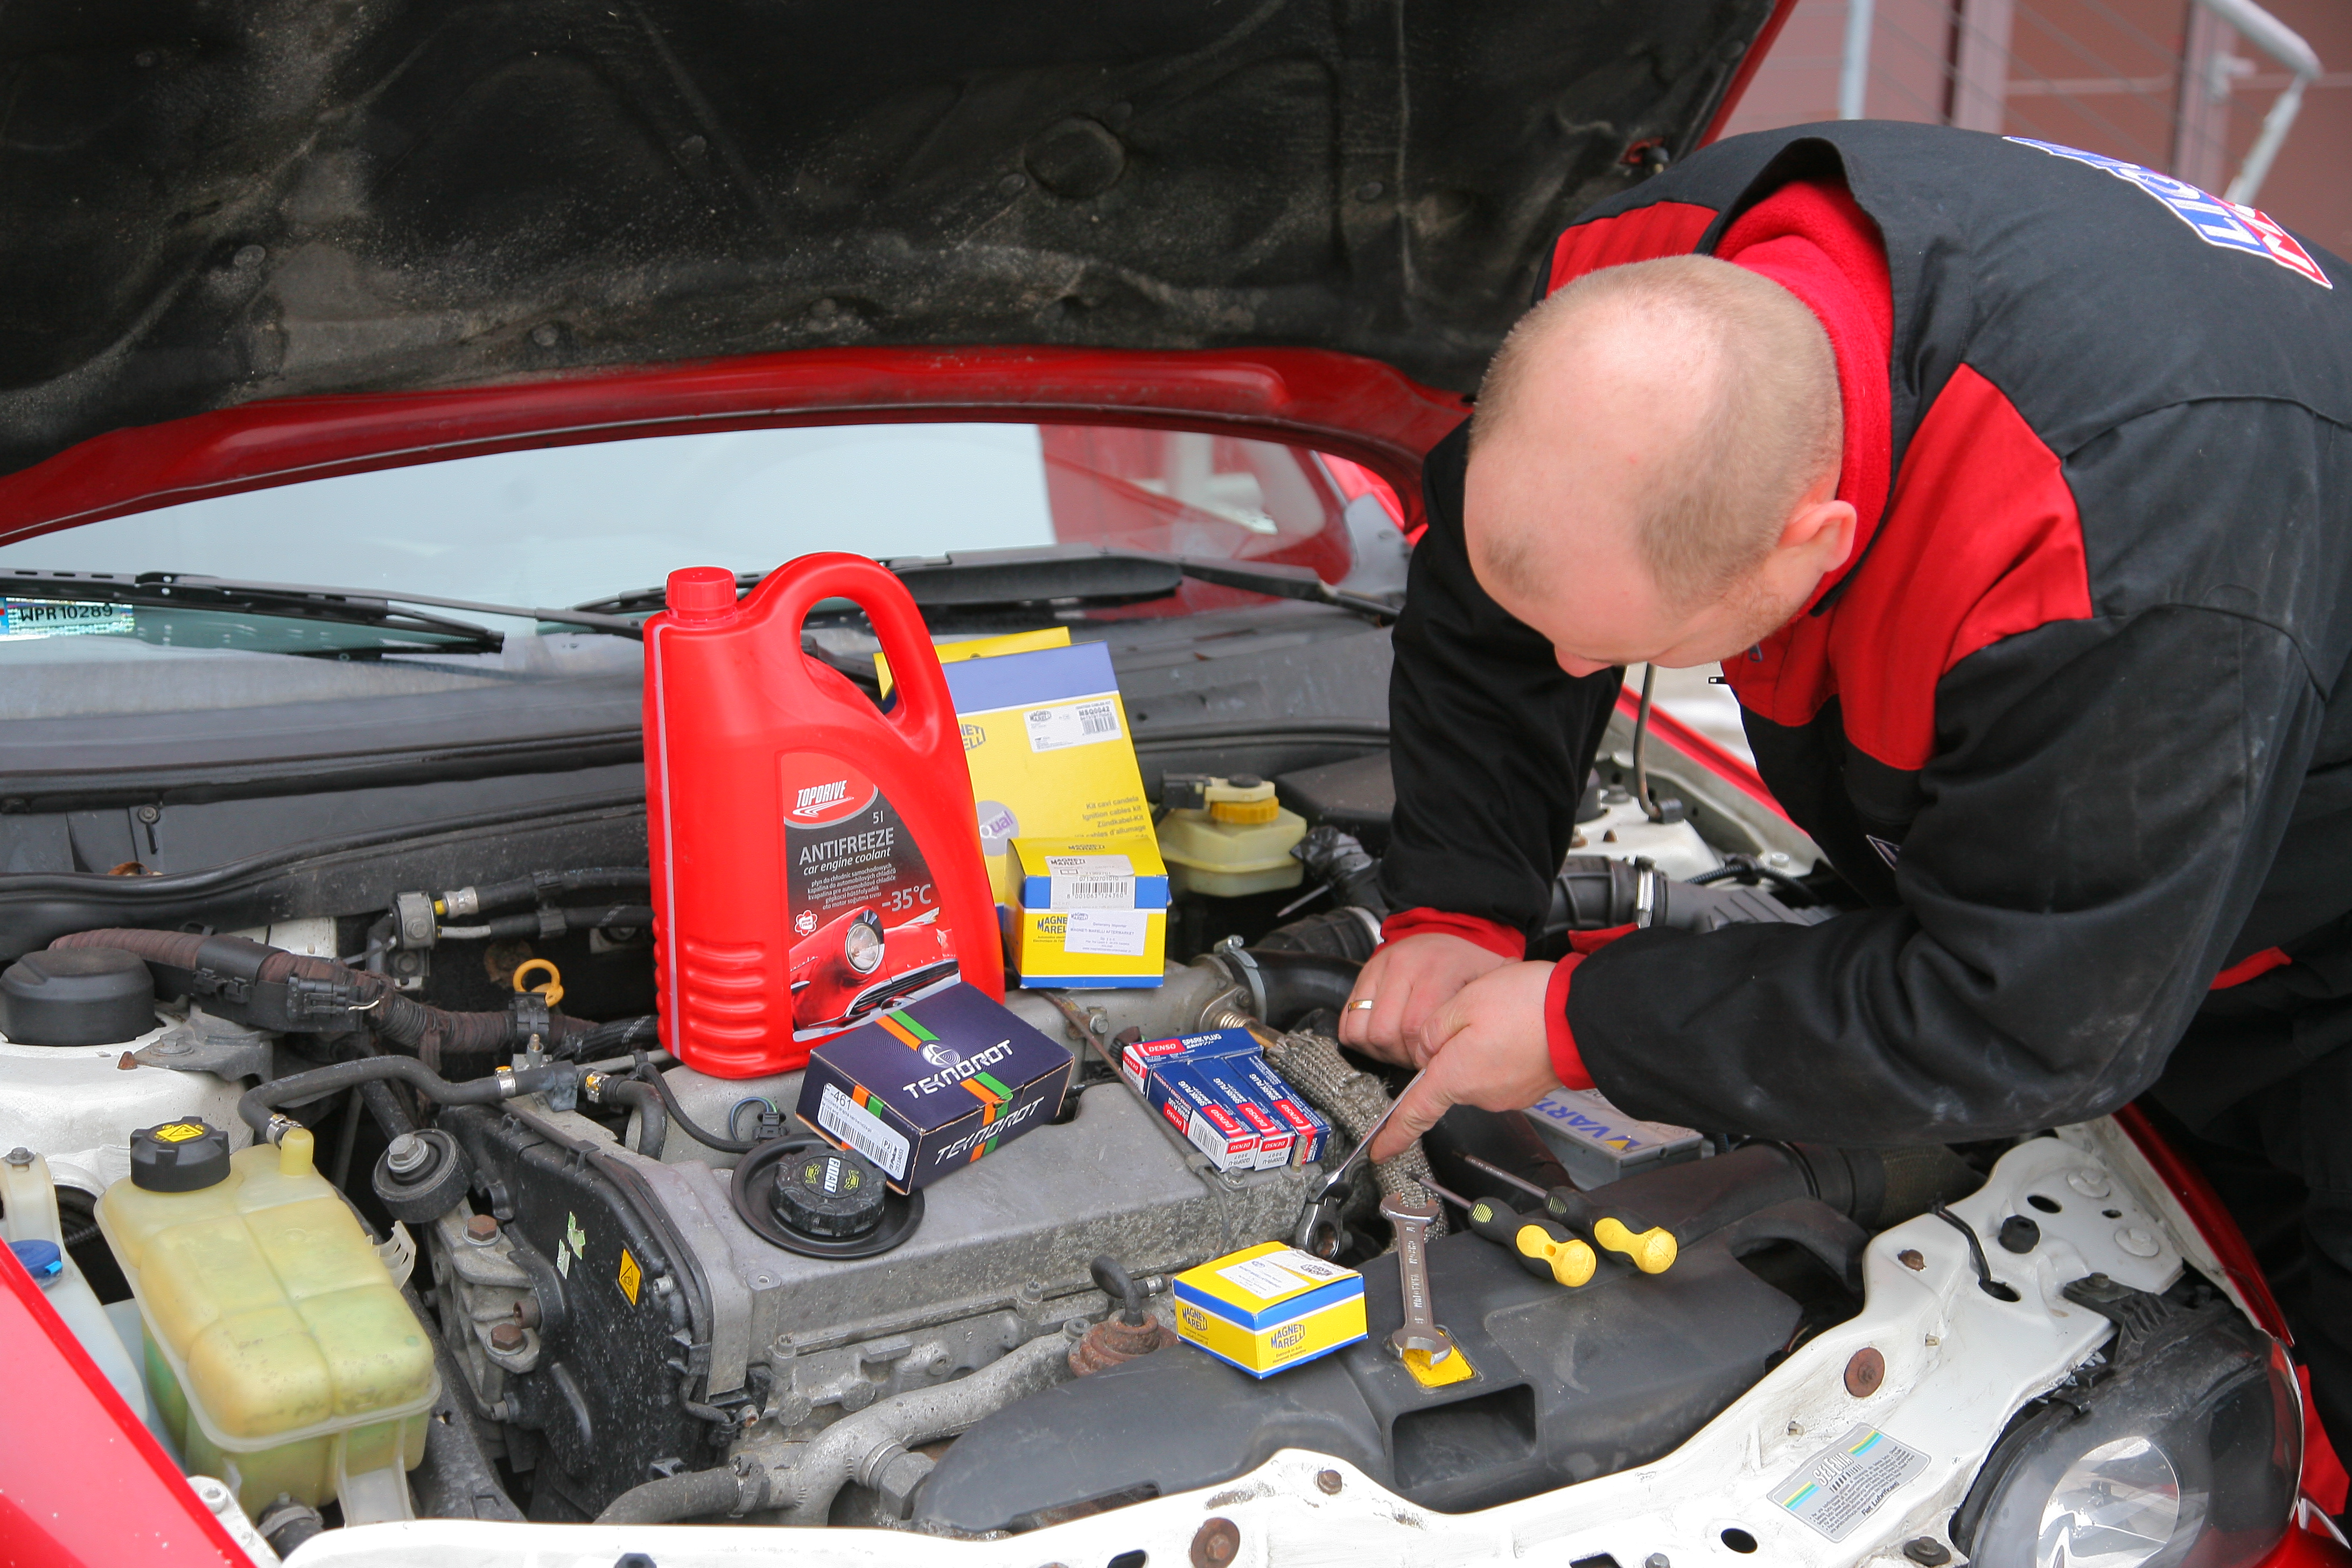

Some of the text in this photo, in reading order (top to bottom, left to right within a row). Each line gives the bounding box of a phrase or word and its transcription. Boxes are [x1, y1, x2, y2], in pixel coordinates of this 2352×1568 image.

[1079, 705, 1110, 716] MSQ0042
[796, 780, 847, 808] TOPDRIVE
[799, 827, 894, 865] ANTIFREEZE
[803, 847, 891, 876] car engine coolant
[851, 863, 892, 877] samochodowych
[807, 884, 829, 894] kapalina
[837, 872, 876, 887] automobilových
[808, 890, 832, 900] kvapalina
[842, 879, 876, 893] automobilové
[832, 900, 846, 908] motor
[1148, 1043, 1177, 1053] DENSO
[1182, 1036, 1203, 1046] SPARK
[1203, 1033, 1222, 1041] PLUG
[902, 1039, 1014, 1100] TEKNOROT
[1124, 1056, 1139, 1071] DENSO
[1177, 1080, 1194, 1094] PLUG
[1212, 1077, 1228, 1090] PLUG
[1248, 1073, 1264, 1086] PLUG
[1168, 1097, 1179, 1110] PLUG
[1166, 1109, 1182, 1127] DENSO
[1209, 1108, 1234, 1129] DENSO
[1244, 1107, 1268, 1127] DENSO
[1280, 1103, 1304, 1124] DENSO
[1533, 1097, 1611, 1139] VART
[934, 1096, 1045, 1166] TEKNOROT
[1229, 1140, 1252, 1152] DENSO
[1264, 1139, 1286, 1150] DENSO
[824, 1157, 841, 1193] FIAT
[1182, 1307, 1208, 1325] MAGNETI
[1182, 1313, 1208, 1332] MARELLI
[1271, 1324, 1305, 1341] MAGNETI
[1271, 1332, 1305, 1349] MARELLI
